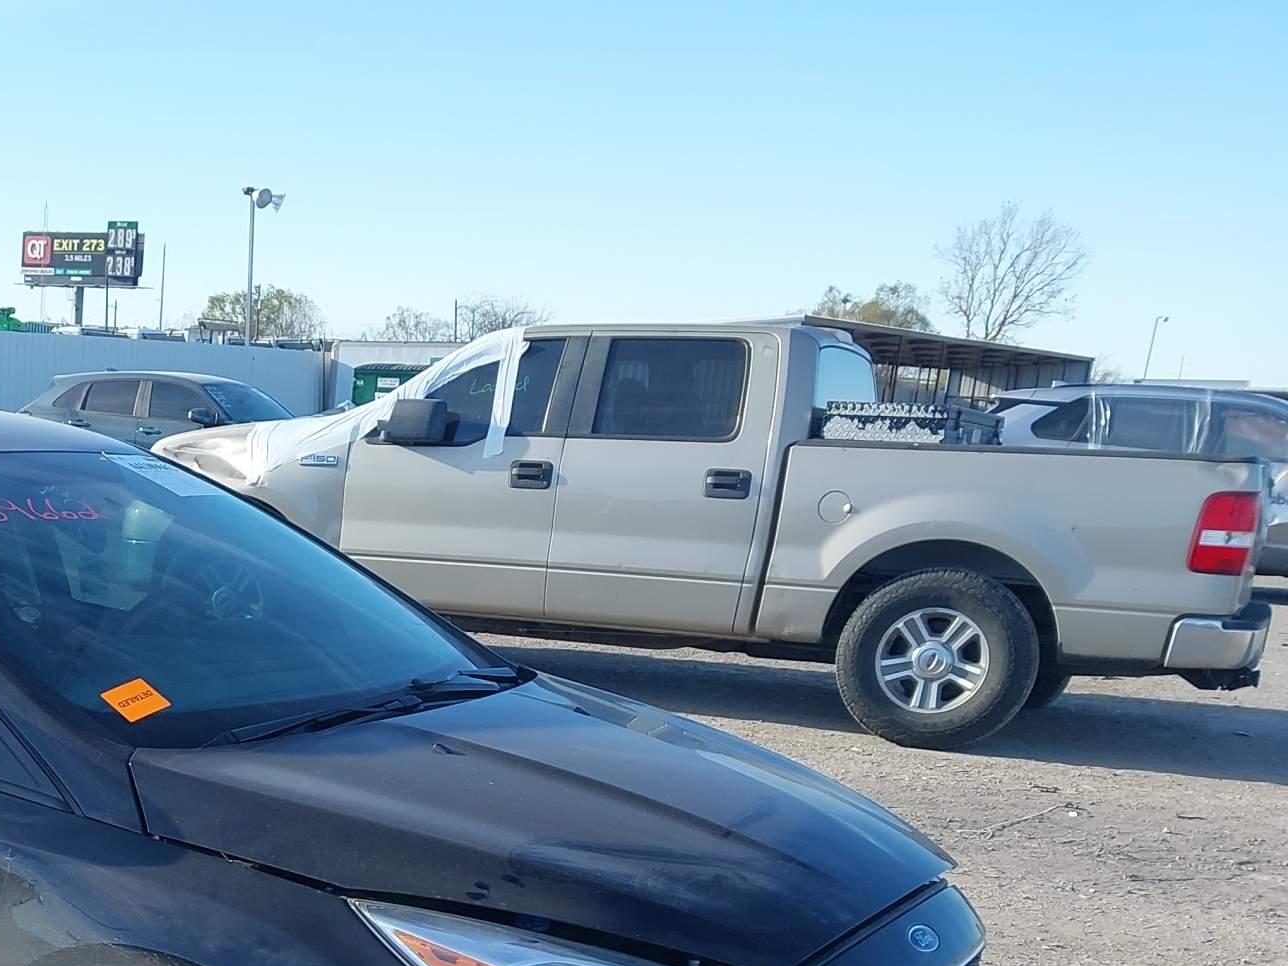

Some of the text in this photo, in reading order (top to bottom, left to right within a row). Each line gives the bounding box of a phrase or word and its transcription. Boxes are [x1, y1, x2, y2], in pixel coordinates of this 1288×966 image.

[27, 239, 47, 259] QT
[53, 239, 105, 251] EXIT 273
[118, 689, 153, 708] DETAILED
